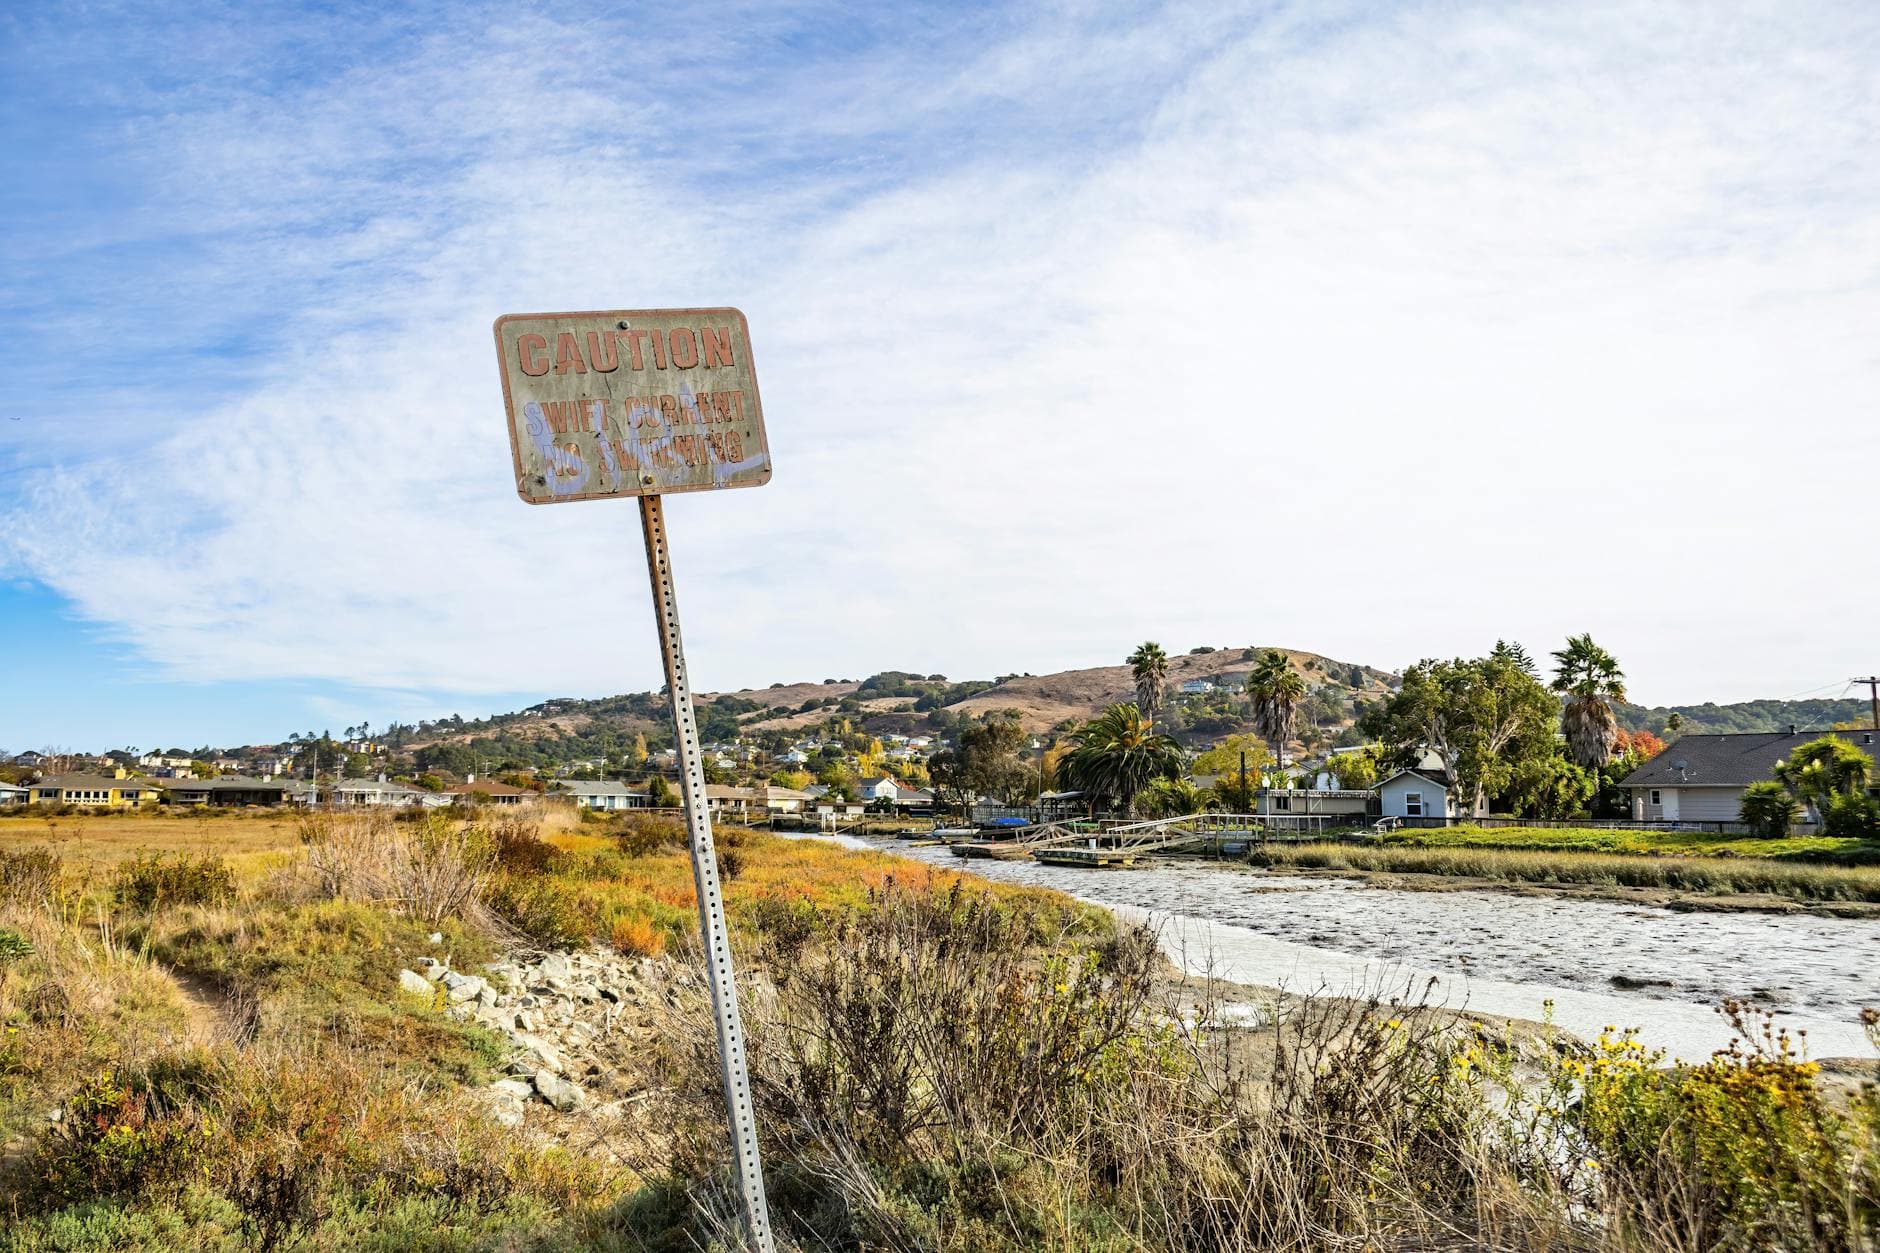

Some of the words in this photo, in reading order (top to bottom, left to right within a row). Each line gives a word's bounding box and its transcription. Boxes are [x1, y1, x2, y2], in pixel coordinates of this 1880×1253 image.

[518, 327, 735, 376] CAUTION
[524, 399, 610, 436] SWIFT
[625, 390, 745, 429] CURRENT
[543, 442, 582, 476] NO
[598, 431, 744, 472] SWIMMING
